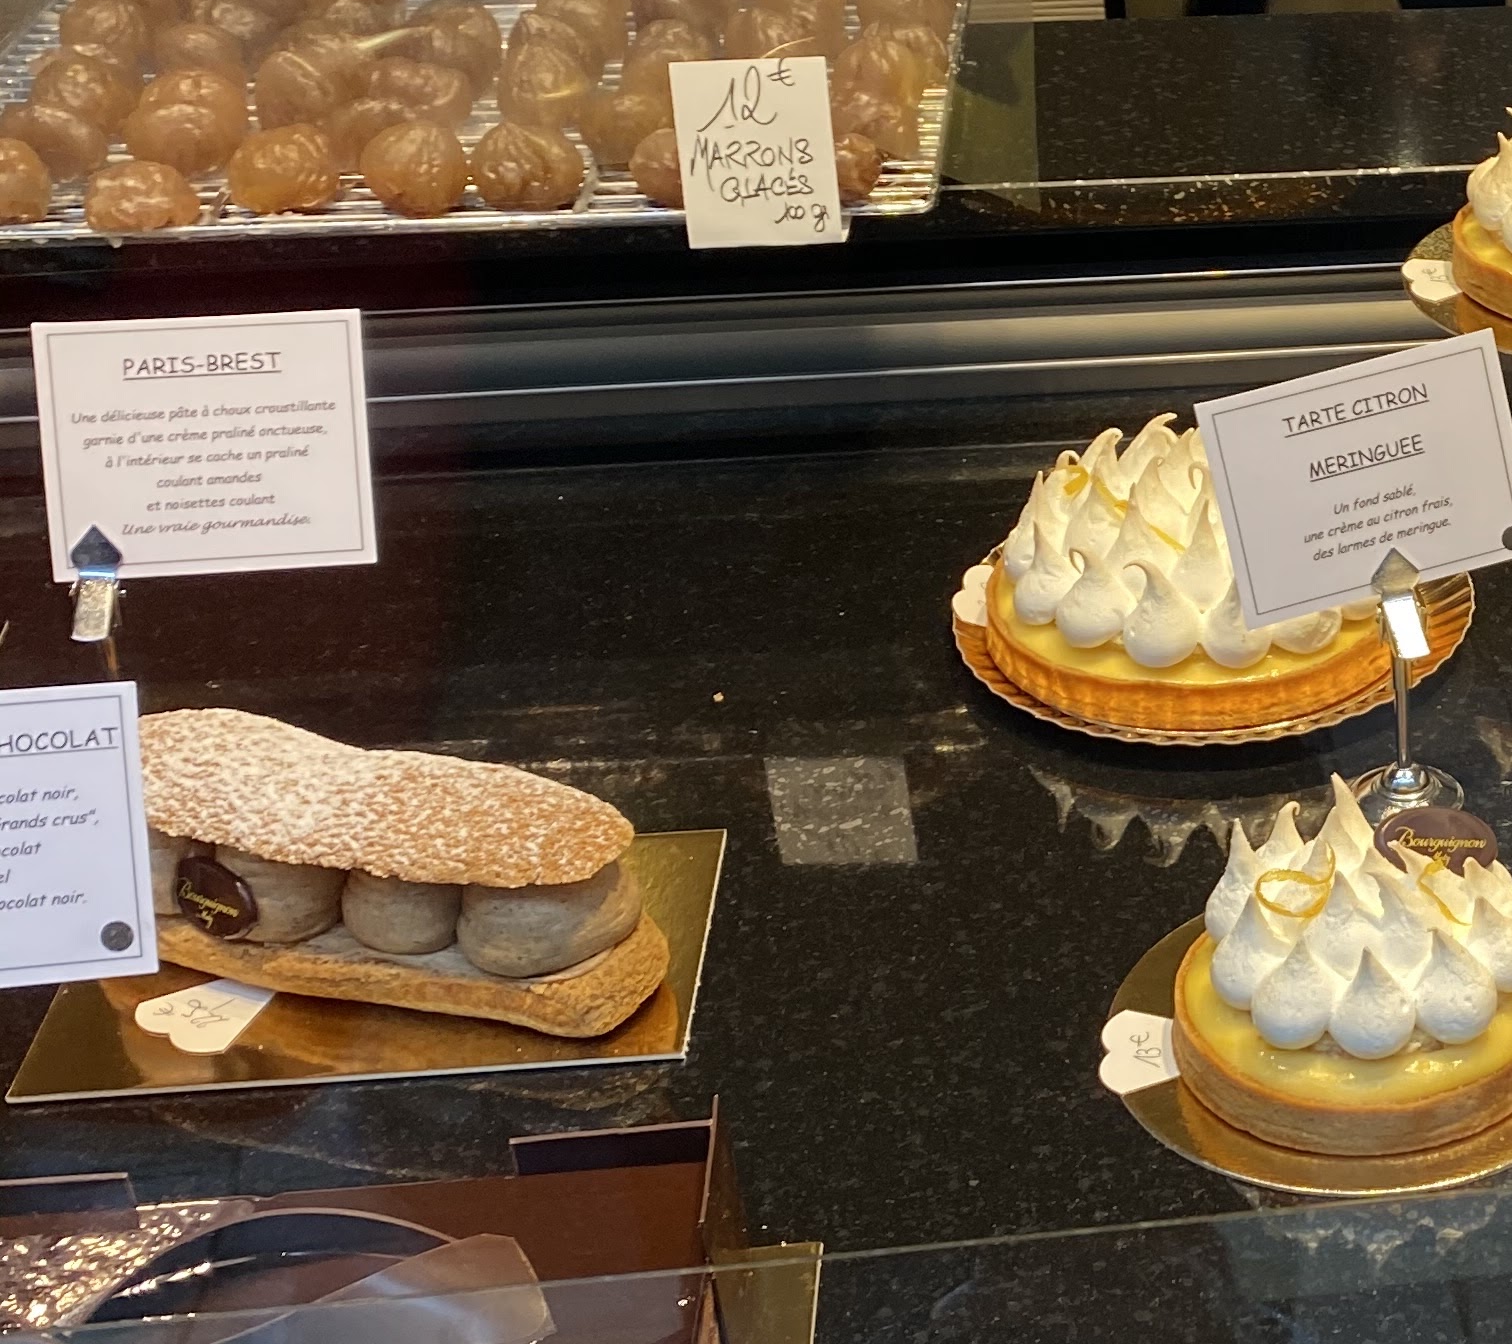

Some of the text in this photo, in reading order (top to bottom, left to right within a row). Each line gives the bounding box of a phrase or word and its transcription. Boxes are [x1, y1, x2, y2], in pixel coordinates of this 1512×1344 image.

[690, 134, 814, 191] MARRONS
[123, 352, 282, 376] PARIS-BREST
[71, 400, 336, 424] Une délicieuse pâte à choux croustillante
[1282, 383, 1428, 434] TARTE CITRON
[83, 433, 124, 450] garnie
[127, 431, 164, 444] d'une
[167, 428, 208, 442] crème
[211, 425, 256, 442] praliné
[105, 455, 113, 468] à
[187, 454, 202, 464] se
[206, 449, 243, 463] cache
[246, 450, 262, 460] un
[264, 444, 310, 462] praliné
[1309, 434, 1425, 479] MERINGUEE
[156, 471, 262, 488] coulant amandes
[146, 494, 276, 512] et noisettes coulant
[1333, 503, 1350, 515] Un
[1353, 492, 1380, 510] fond
[121, 523, 157, 535] Une
[159, 520, 200, 533] vraie
[1303, 531, 1324, 544] une
[1327, 520, 1364, 537] crème
[1366, 516, 1380, 527] au
[1383, 506, 1419, 522] citron
[1312, 546, 1334, 561] des
[1337, 536, 1377, 555] larmes
[1378, 531, 1394, 544] de
[0, 813, 48, 831] rands
[0, 841, 42, 857] colat
[1395, 826, 1487, 853] Bourguignon
